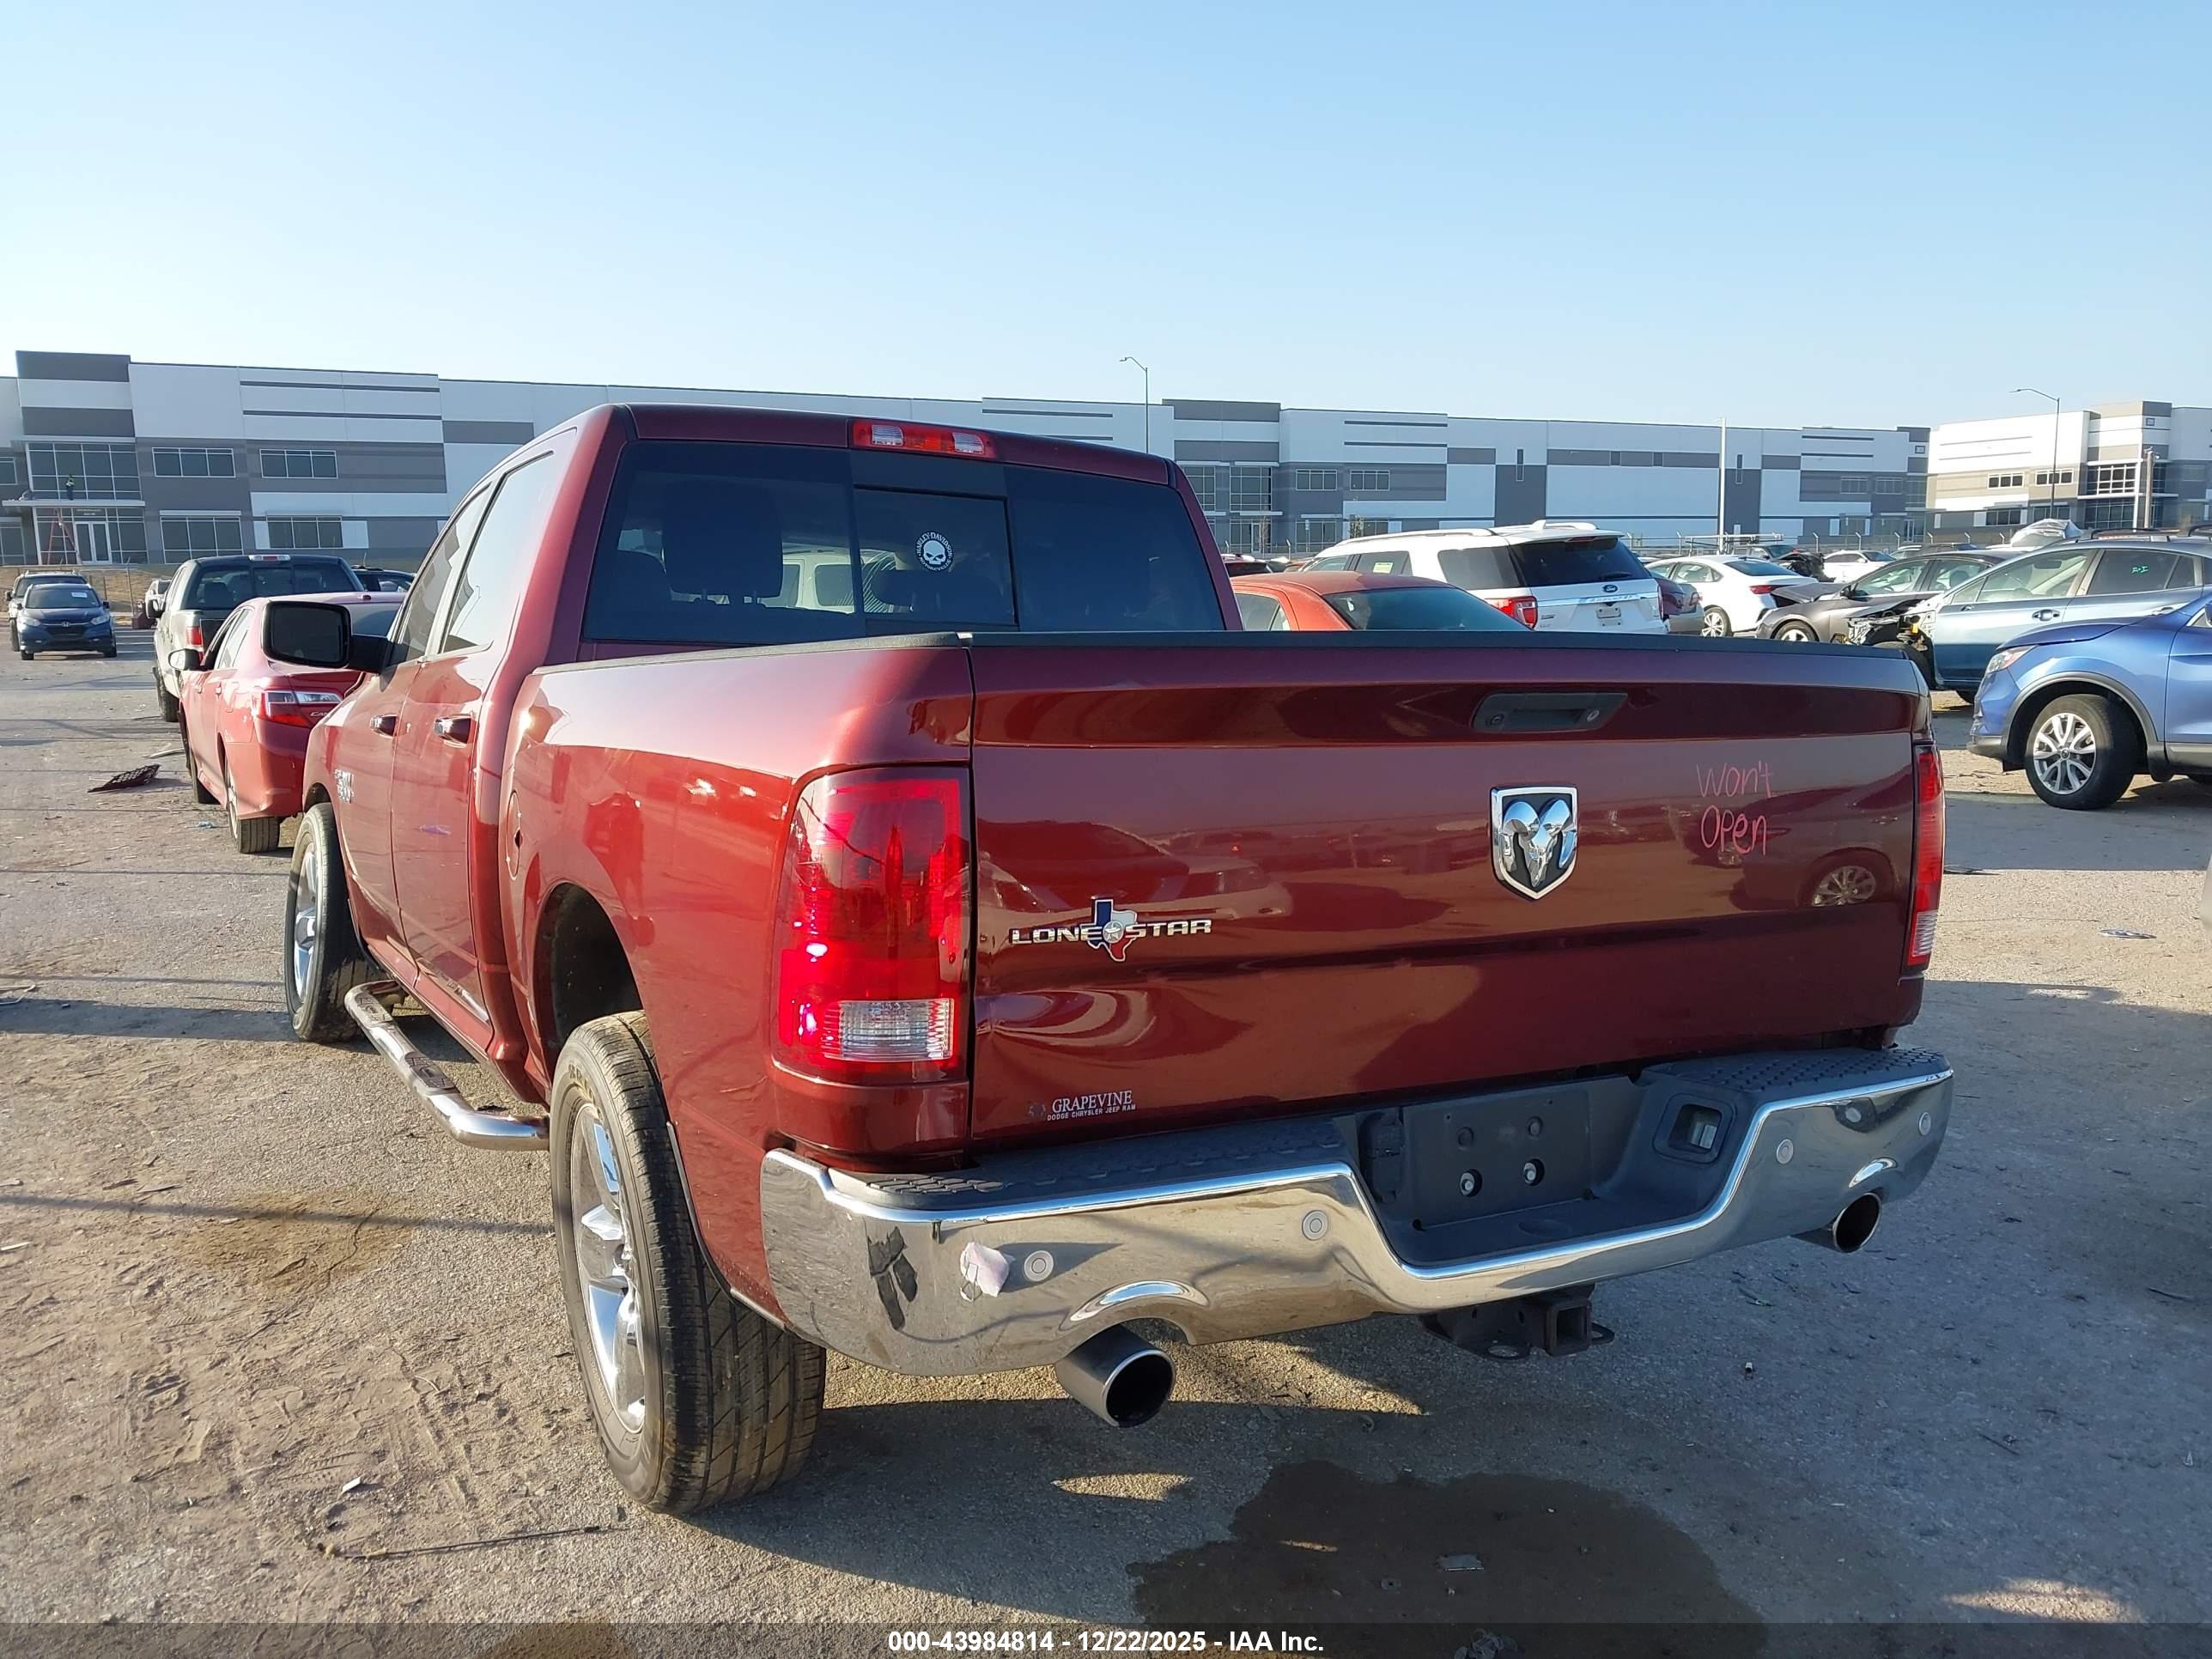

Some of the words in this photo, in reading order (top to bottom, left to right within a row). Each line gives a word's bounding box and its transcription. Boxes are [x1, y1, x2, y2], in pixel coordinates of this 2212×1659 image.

[916, 532, 953, 557] HARLEY-DAVIDSON
[1011, 926, 1103, 945] LONE
[1124, 919, 1212, 939] STAR
[1047, 1112, 1069, 1121] DODGE
[1072, 1108, 1103, 1118] CHRYSLER
[1105, 1105, 1121, 1114] JEEP
[1122, 1103, 1136, 1112] RAM
[1052, 1090, 1133, 1114] GRAPEVINE
